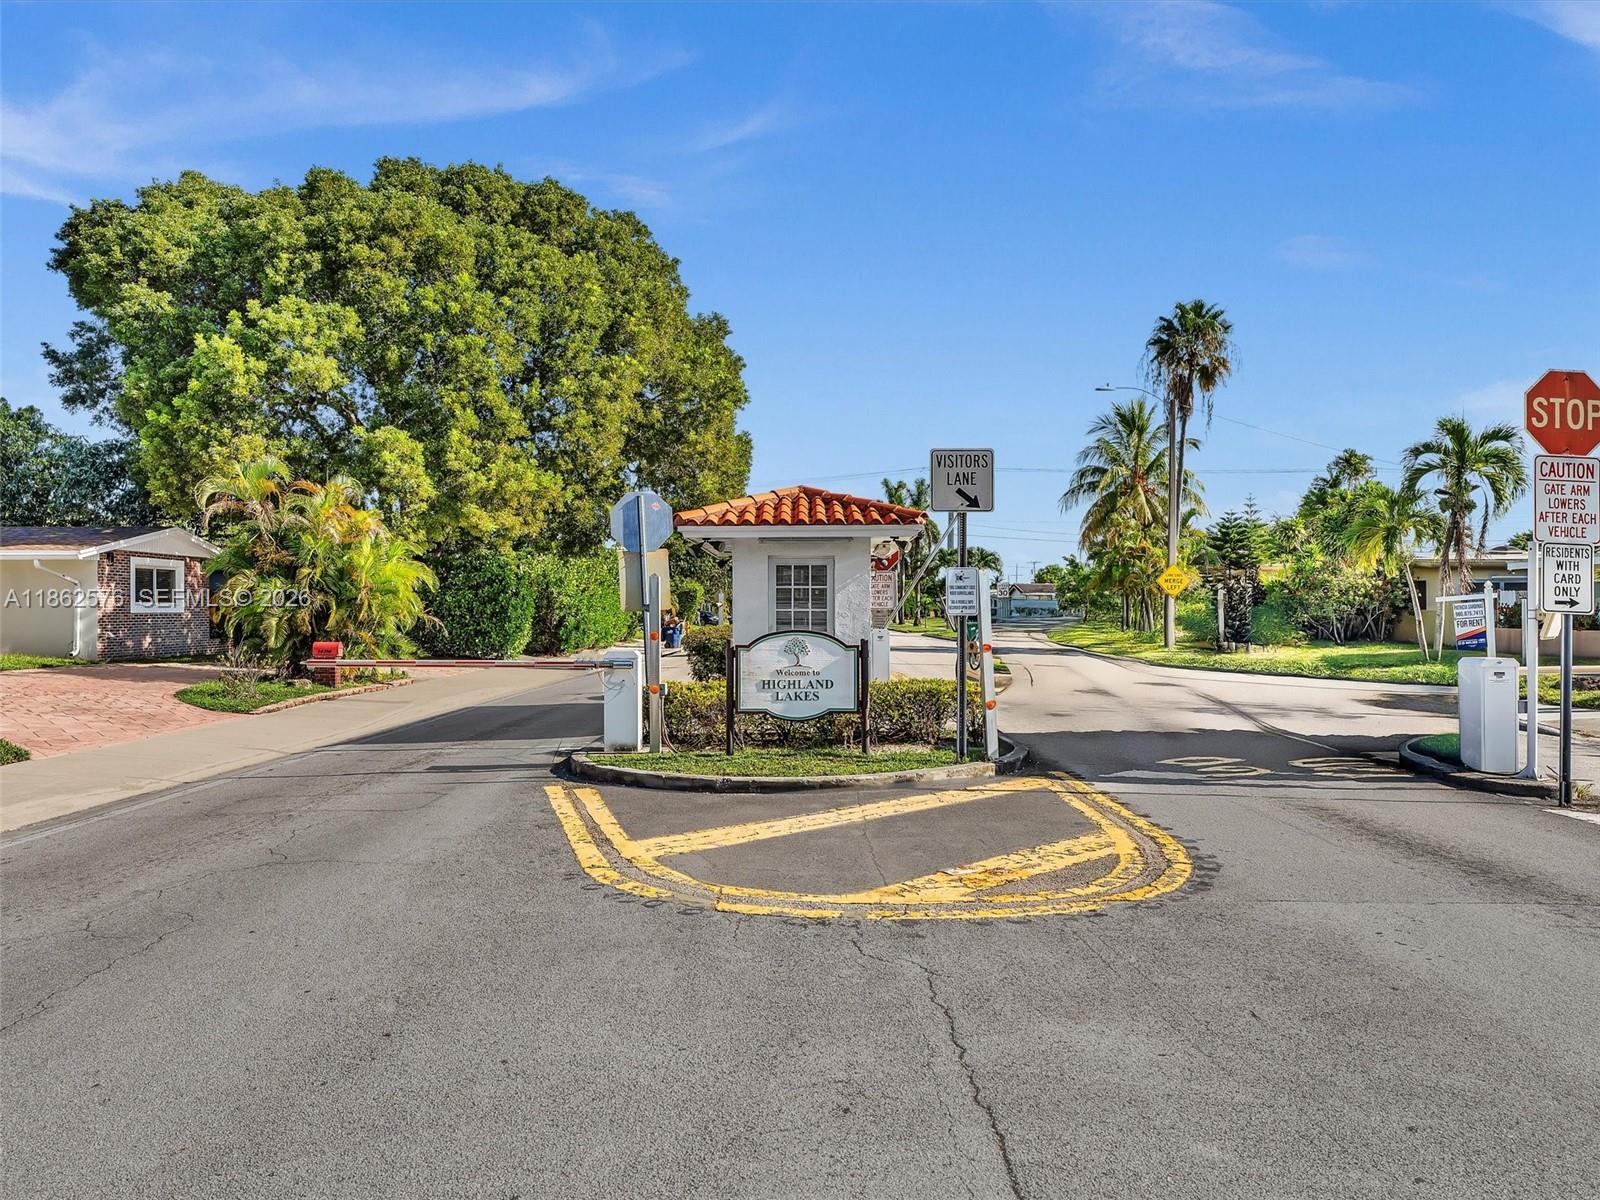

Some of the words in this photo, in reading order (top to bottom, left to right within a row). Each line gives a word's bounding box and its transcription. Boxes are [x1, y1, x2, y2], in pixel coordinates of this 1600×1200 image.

[1531, 396, 1600, 431] STOP
[935, 454, 988, 468] VISITORS
[1540, 461, 1595, 479] CAUTION
[947, 471, 977, 486] LANE
[1544, 483, 1566, 495] GATE
[1570, 484, 1590, 497] ARM
[1548, 497, 1586, 511] LOWERS
[1538, 511, 1568, 524] AFTER
[1572, 512, 1597, 525] EACH
[1548, 526, 1587, 539] VEHICLE
[1545, 546, 1590, 559] RESIDENTS
[1555, 560, 1580, 571] WITH
[1553, 572, 1581, 585] CARD
[1554, 585, 1581, 598] ONLY
[1456, 619, 1468, 628] FOR
[1468, 618, 1483, 627] RENT
[775, 669, 811, 677] Welcome
[812, 669, 821, 677] to
[761, 679, 834, 690] HIGHLAND
[775, 691, 820, 701] LAKES
